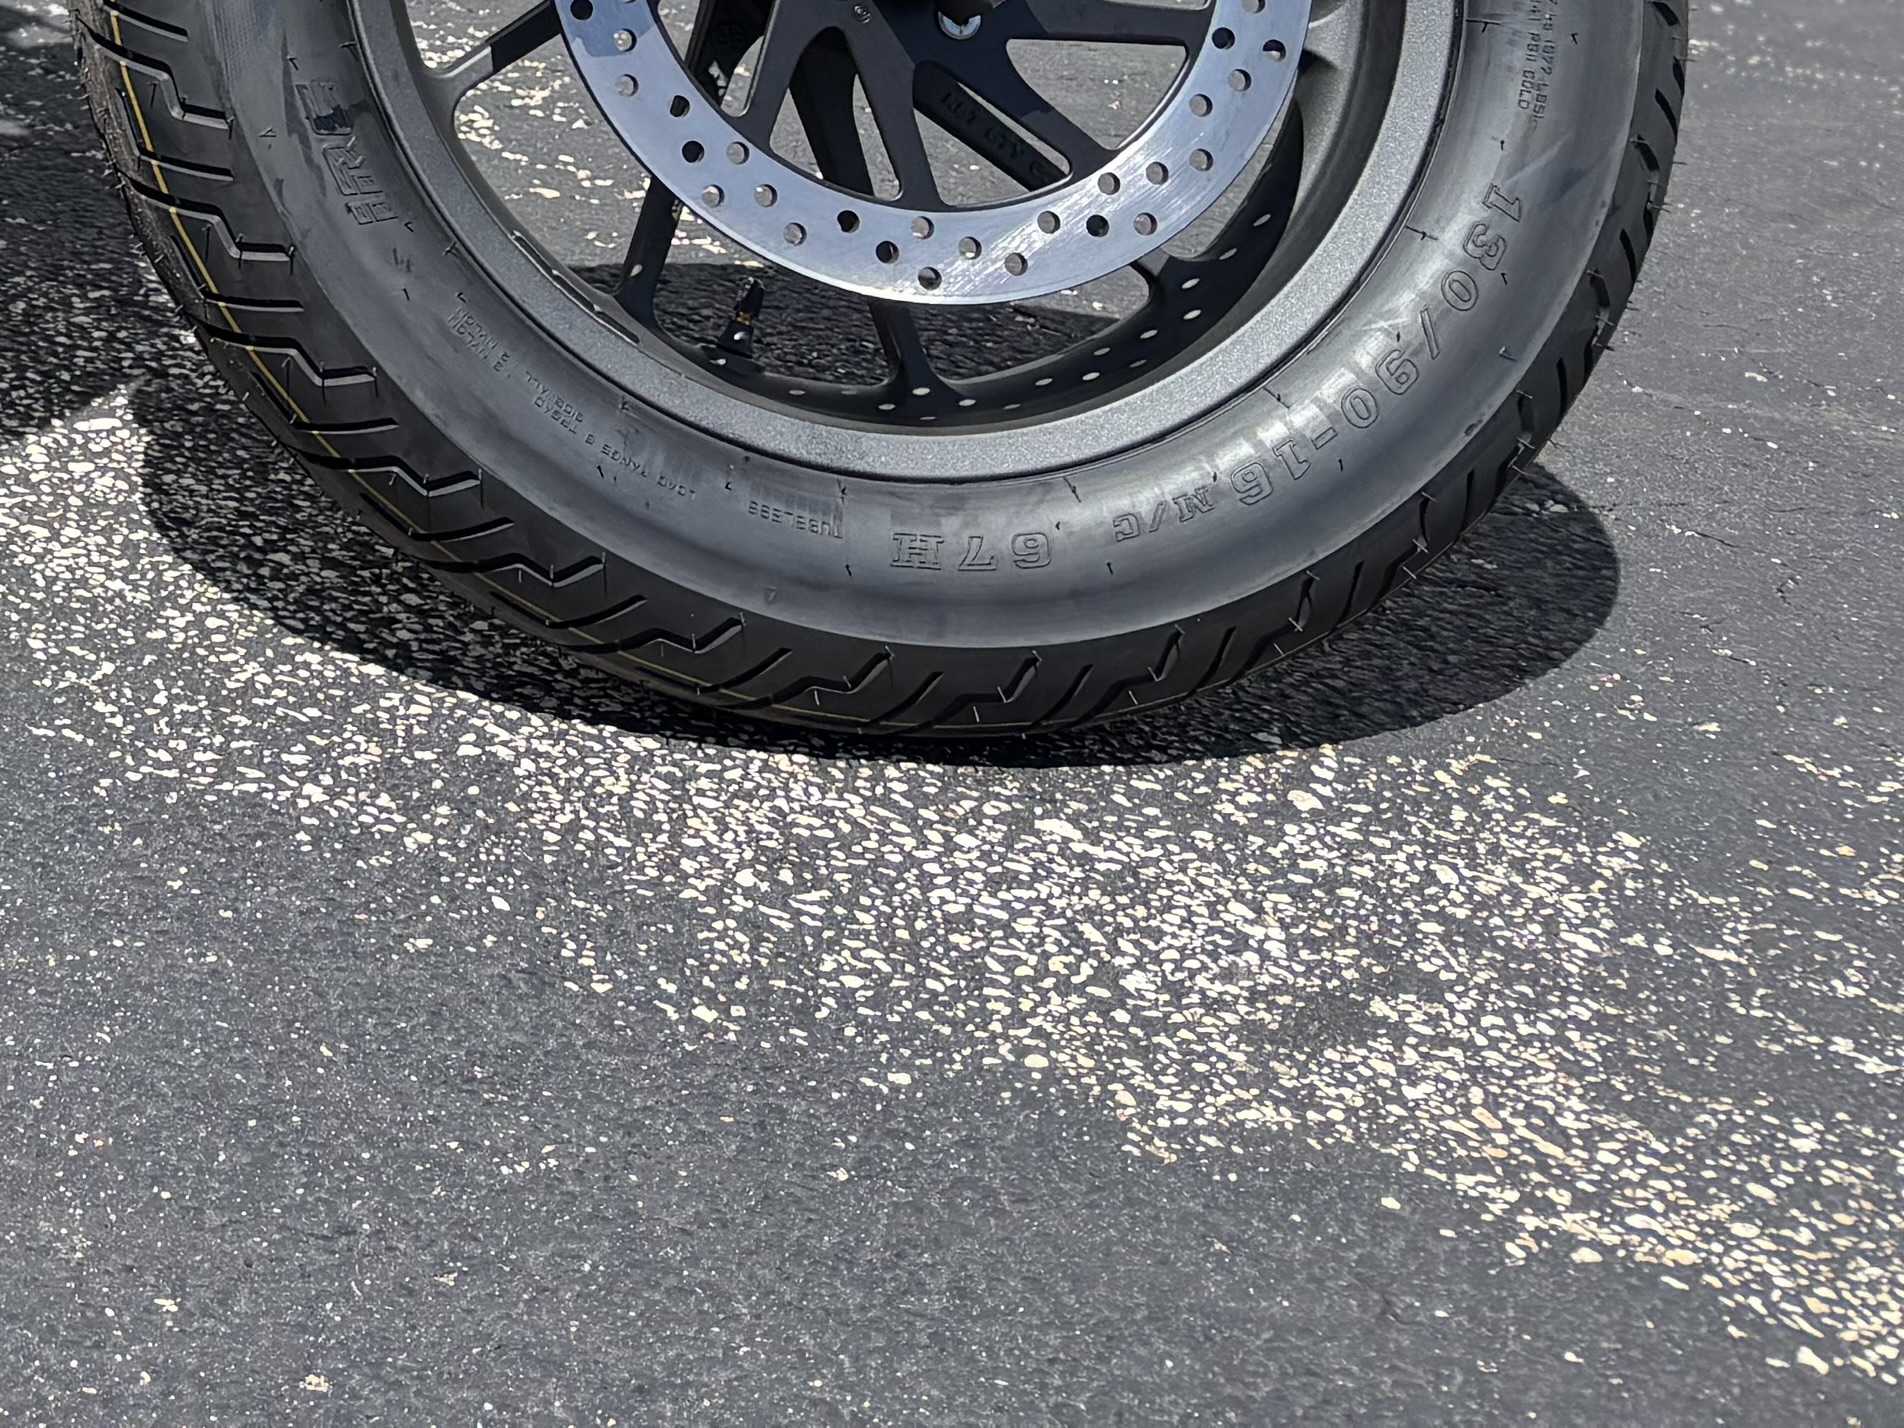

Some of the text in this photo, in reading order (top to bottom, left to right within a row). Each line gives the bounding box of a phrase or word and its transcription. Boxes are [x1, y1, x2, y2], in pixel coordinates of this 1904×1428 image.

[890, 183, 1524, 573] 130/90-16 M/C 67H
[746, 500, 844, 539] TUBELESS
